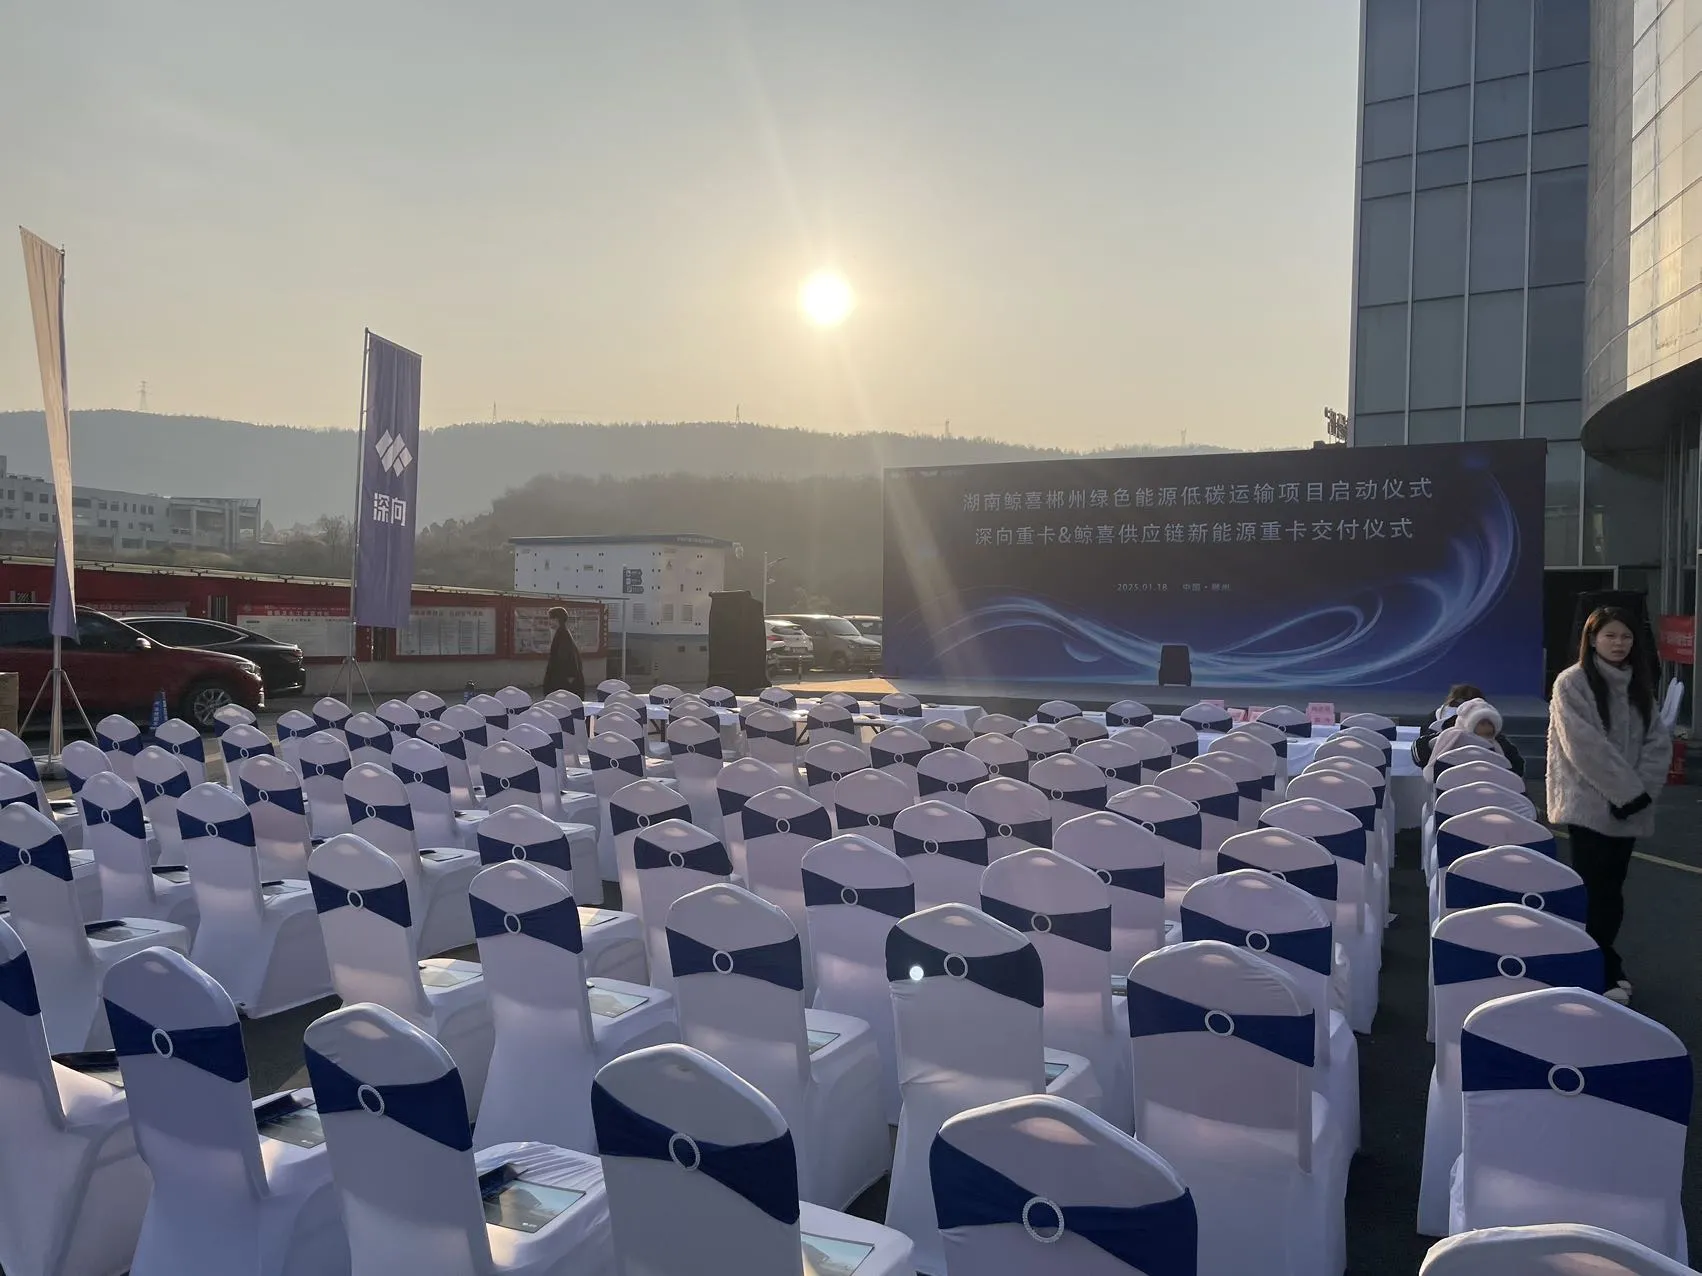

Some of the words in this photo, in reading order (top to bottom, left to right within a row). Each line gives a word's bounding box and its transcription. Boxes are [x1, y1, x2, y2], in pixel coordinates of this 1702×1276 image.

[373, 492, 407, 527] 深向
[963, 476, 1433, 512] 湖南鲸喜郴州绿色能源低碳运输项目启动仪式
[975, 517, 1413, 547] 深向重卡&鲸喜供应链新能源重卡交付仪式
[1117, 582, 1168, 592] 2025.01.18
